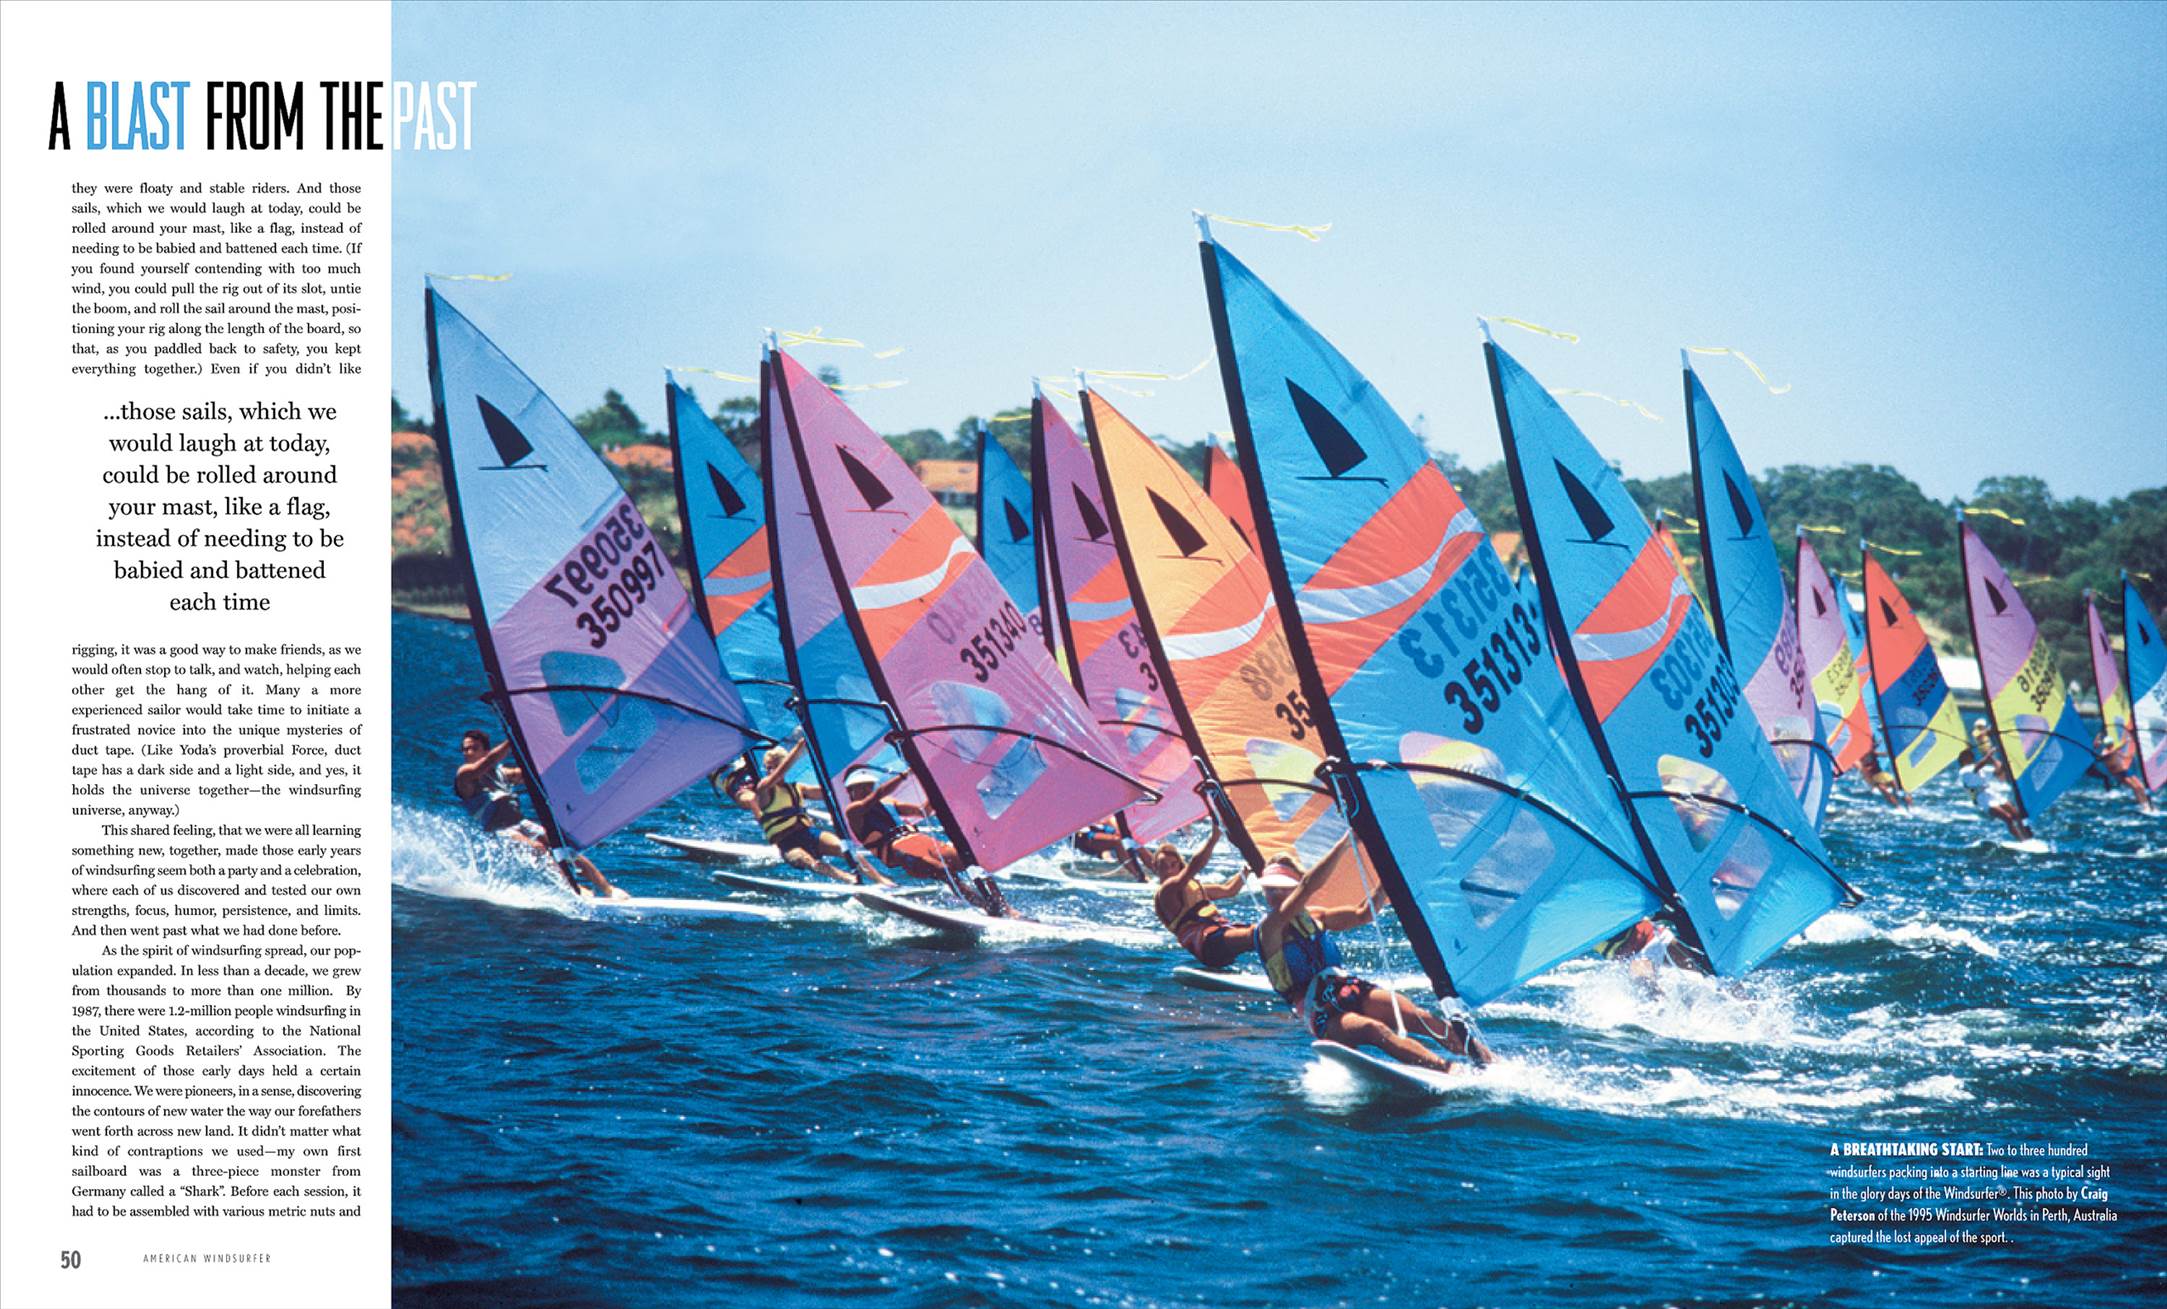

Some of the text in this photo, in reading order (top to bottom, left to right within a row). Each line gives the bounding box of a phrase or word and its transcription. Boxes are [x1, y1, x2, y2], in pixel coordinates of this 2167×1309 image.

[71, 181, 362, 197] they were floaty and stable riders. And those
[70, 262, 361, 277] you found yourself contending with too much
[103, 400, 337, 424] ...those sails, which we
[108, 432, 330, 458] would laugh at today,
[102, 464, 338, 484] could be rolled around
[108, 496, 331, 521] your mast, like a flag,
[95, 527, 344, 553] instead of needing to be
[113, 559, 327, 580] babied and battened
[169, 591, 271, 612] each time
[576, 540, 665, 649] 350997
[959, 600, 1027, 683] 351340
[1444, 602, 1541, 735] 351313
[71, 703, 362, 719] experienced sailor would take time to initiate a
[71, 723, 364, 739] frustrated novice into the unique mysteries of
[71, 843, 362, 859] something new, together, made those early years
[71, 903, 361, 919] strengths, focus, humor, persistence, and limits.
[71, 1004, 361, 1020] 1987, there were 1.2-million people windsurfing in
[71, 1024, 361, 1040] the United States, according to the National
[71, 1164, 361, 1180] sailboard was a three-piece monster from
[60, 1250, 82, 1271] 50
[143, 1253, 271, 1264] AMERICAN WINDSURFER
